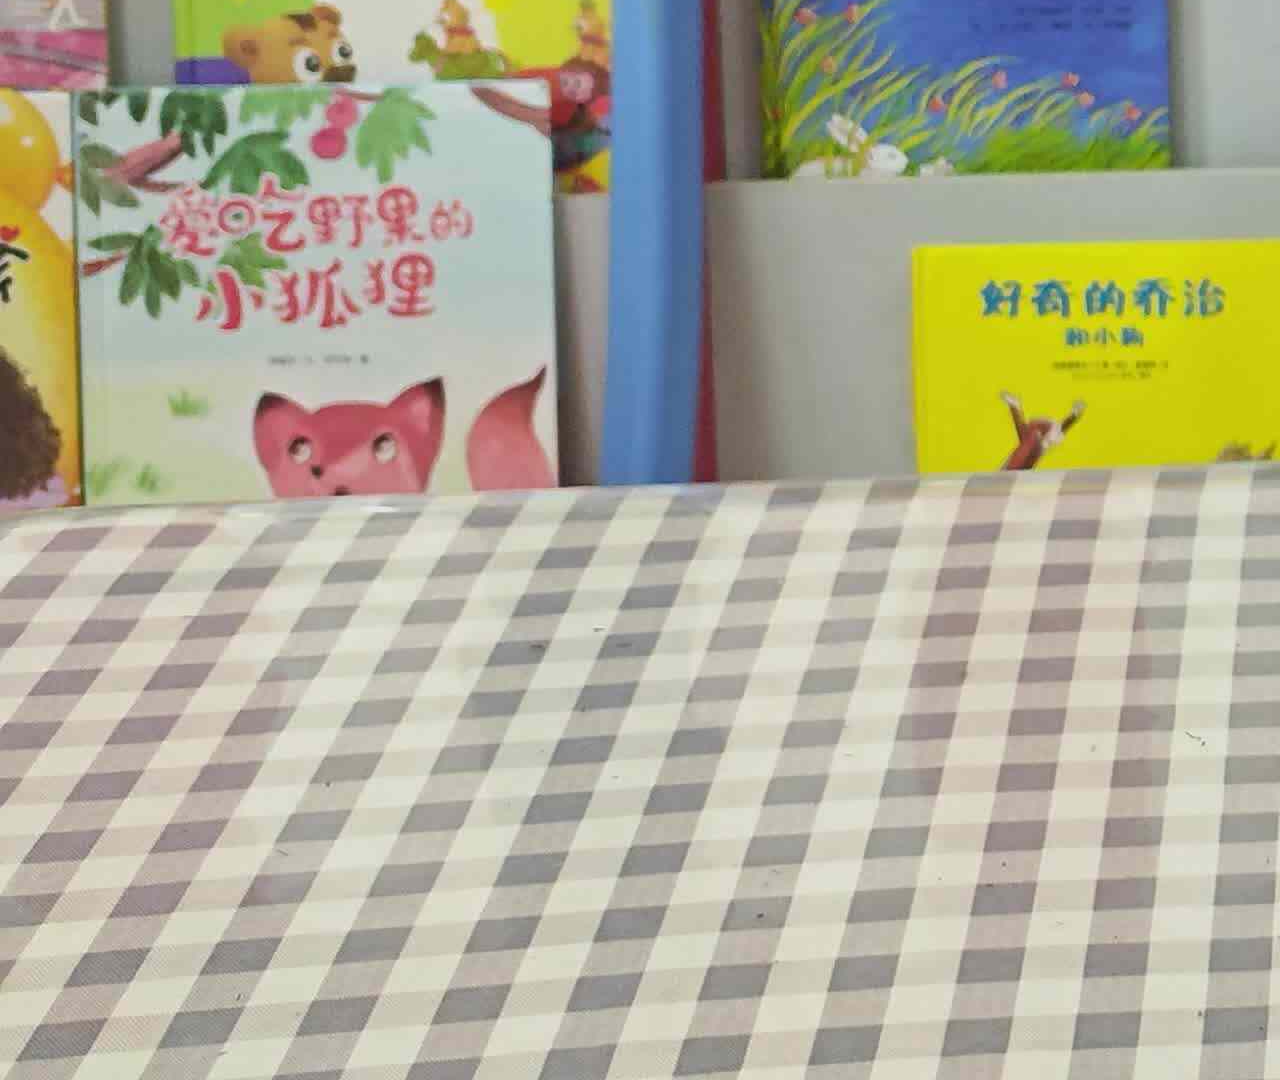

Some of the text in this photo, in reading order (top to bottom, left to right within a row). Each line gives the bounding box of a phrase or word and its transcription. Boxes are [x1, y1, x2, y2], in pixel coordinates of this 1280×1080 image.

[158, 172, 473, 258] 爱吃野果的
[195, 251, 440, 333] 小狐狸
[979, 277, 1227, 321] 好奇的乔治
